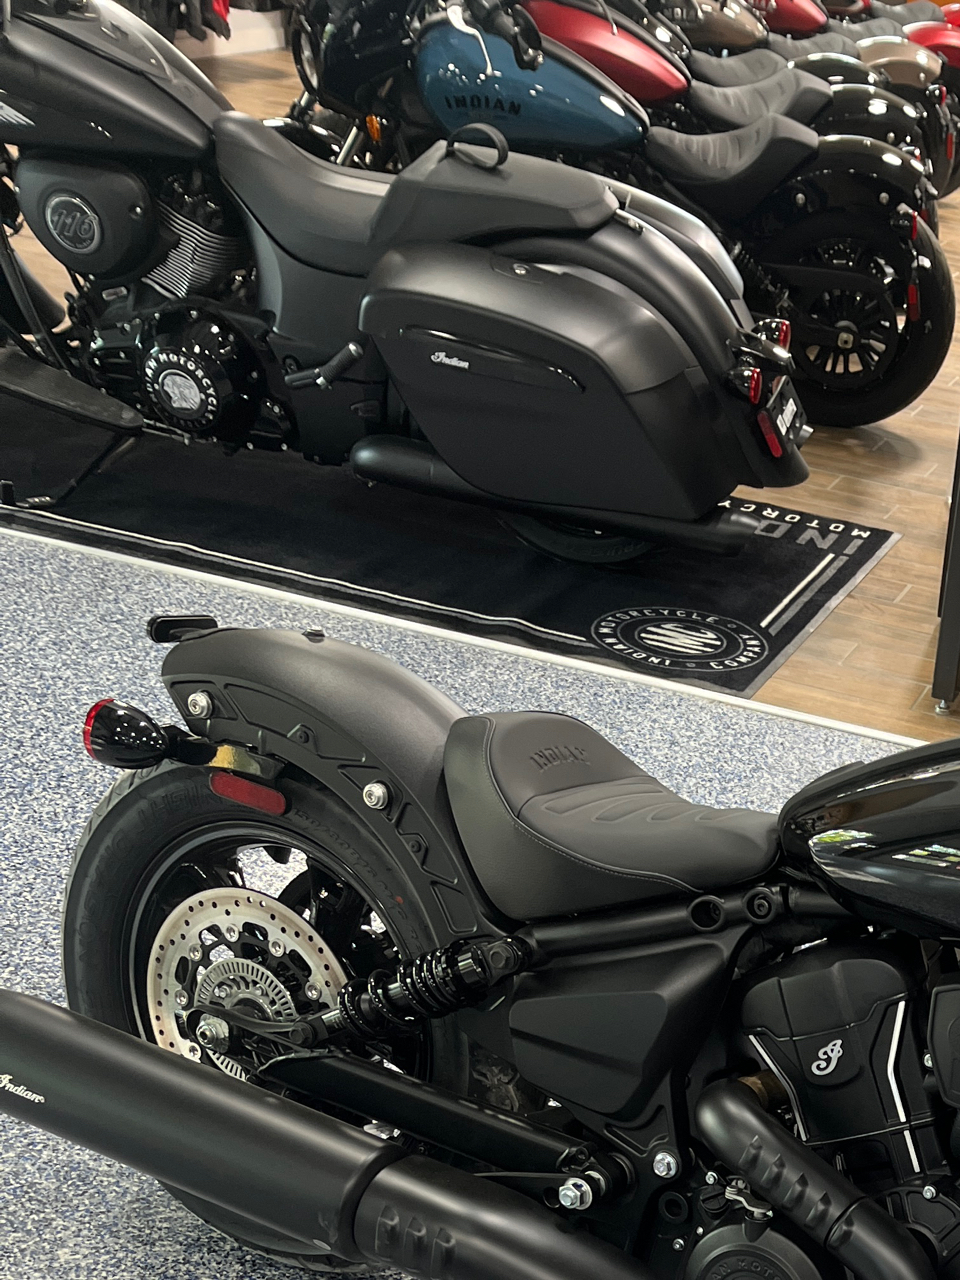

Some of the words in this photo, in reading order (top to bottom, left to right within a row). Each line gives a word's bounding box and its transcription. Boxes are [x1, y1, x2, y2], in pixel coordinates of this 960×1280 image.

[444, 94, 521, 116] INDIAN
[431, 351, 470, 370] Indian
[717, 499, 872, 539] MOTORCY
[709, 633, 761, 669] COMPANY
[0, 1074, 45, 1103] Indian
